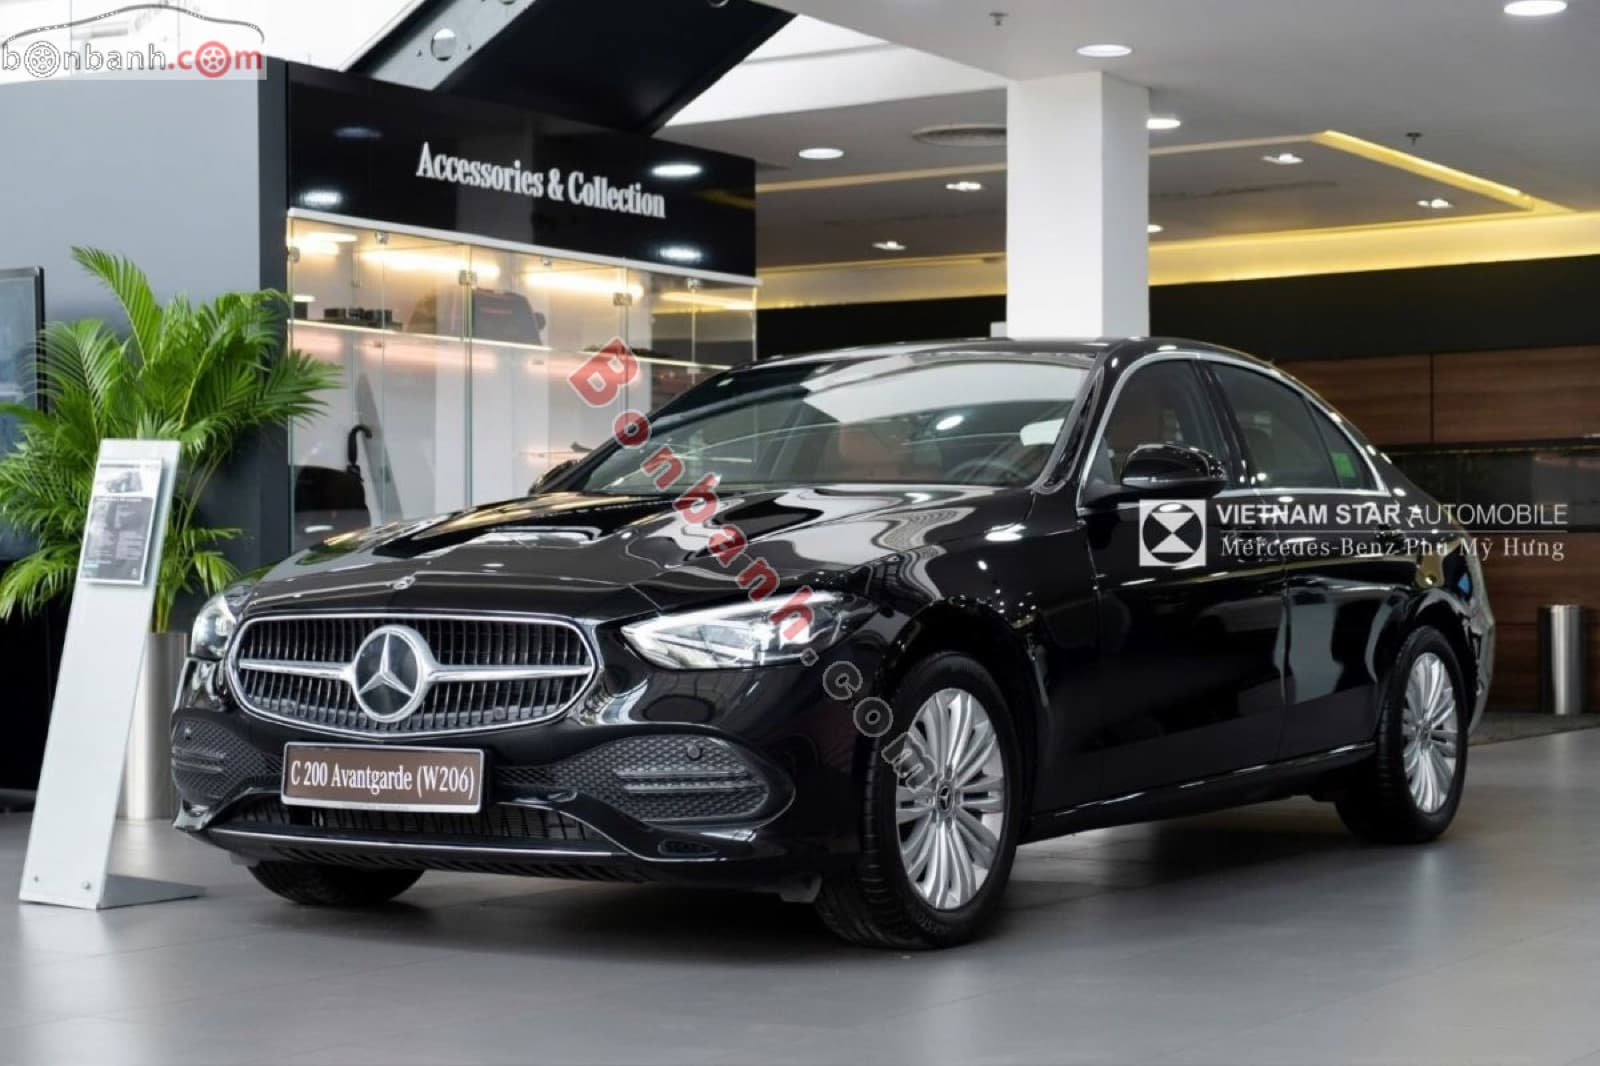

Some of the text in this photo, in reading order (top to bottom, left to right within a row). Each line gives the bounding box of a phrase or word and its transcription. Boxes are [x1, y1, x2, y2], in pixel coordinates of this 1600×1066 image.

[416, 141, 666, 218] Accessories & Collection
[291, 760, 475, 800] C 200 Avantgarde (W206)
